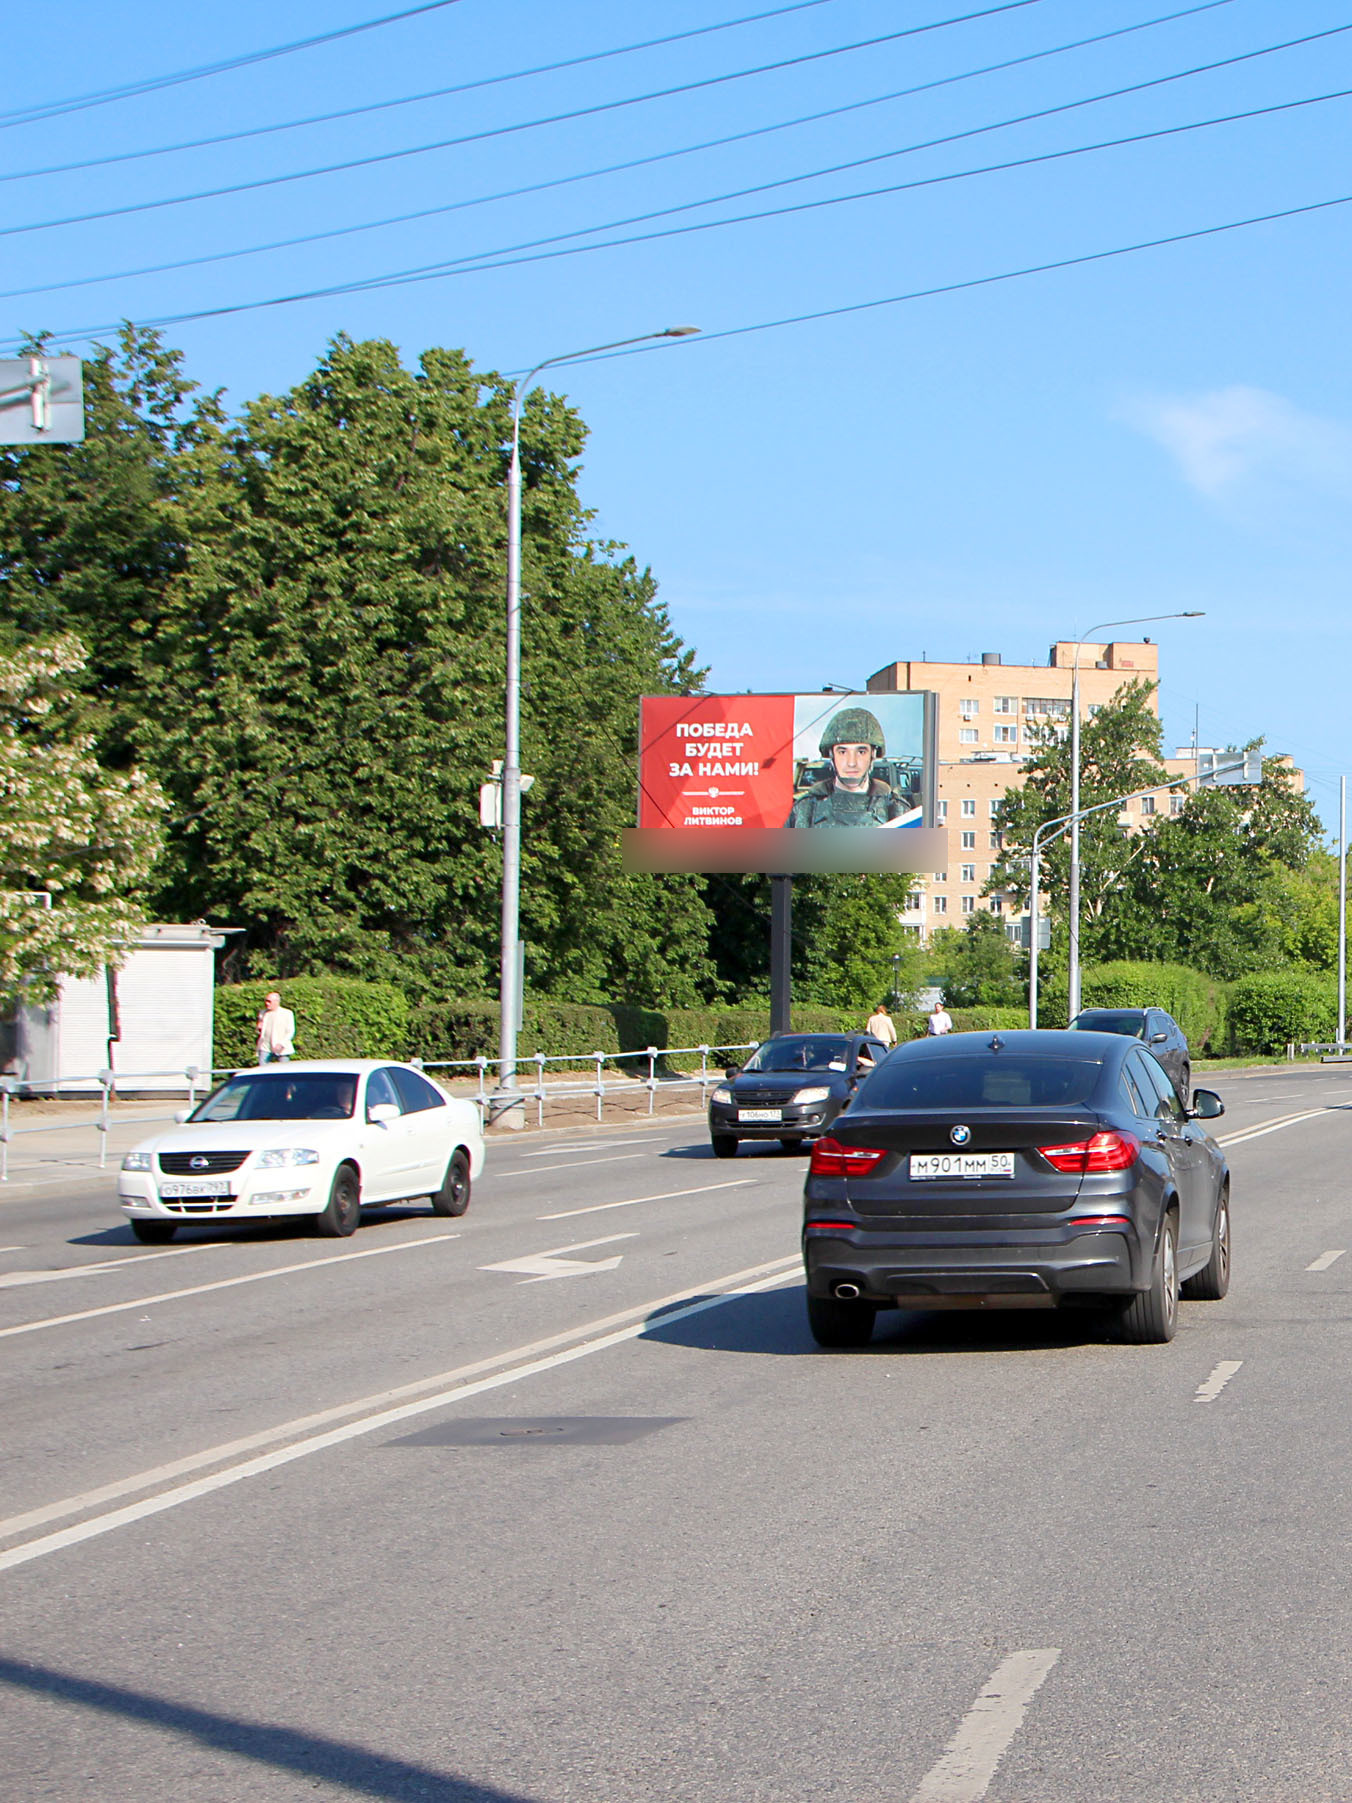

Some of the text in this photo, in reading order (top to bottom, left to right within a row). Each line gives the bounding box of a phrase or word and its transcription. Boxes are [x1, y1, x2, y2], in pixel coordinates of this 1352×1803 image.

[676, 723, 753, 739] ПОБЕДА
[685, 743, 744, 758] БУДЕТ
[669, 762, 759, 777] ЗА НАМИ!
[692, 807, 735, 816] ВИКТОР
[684, 817, 743, 825] ЛИТВИНОВ
[917, 1155, 1008, 1173] М901ММ 50
